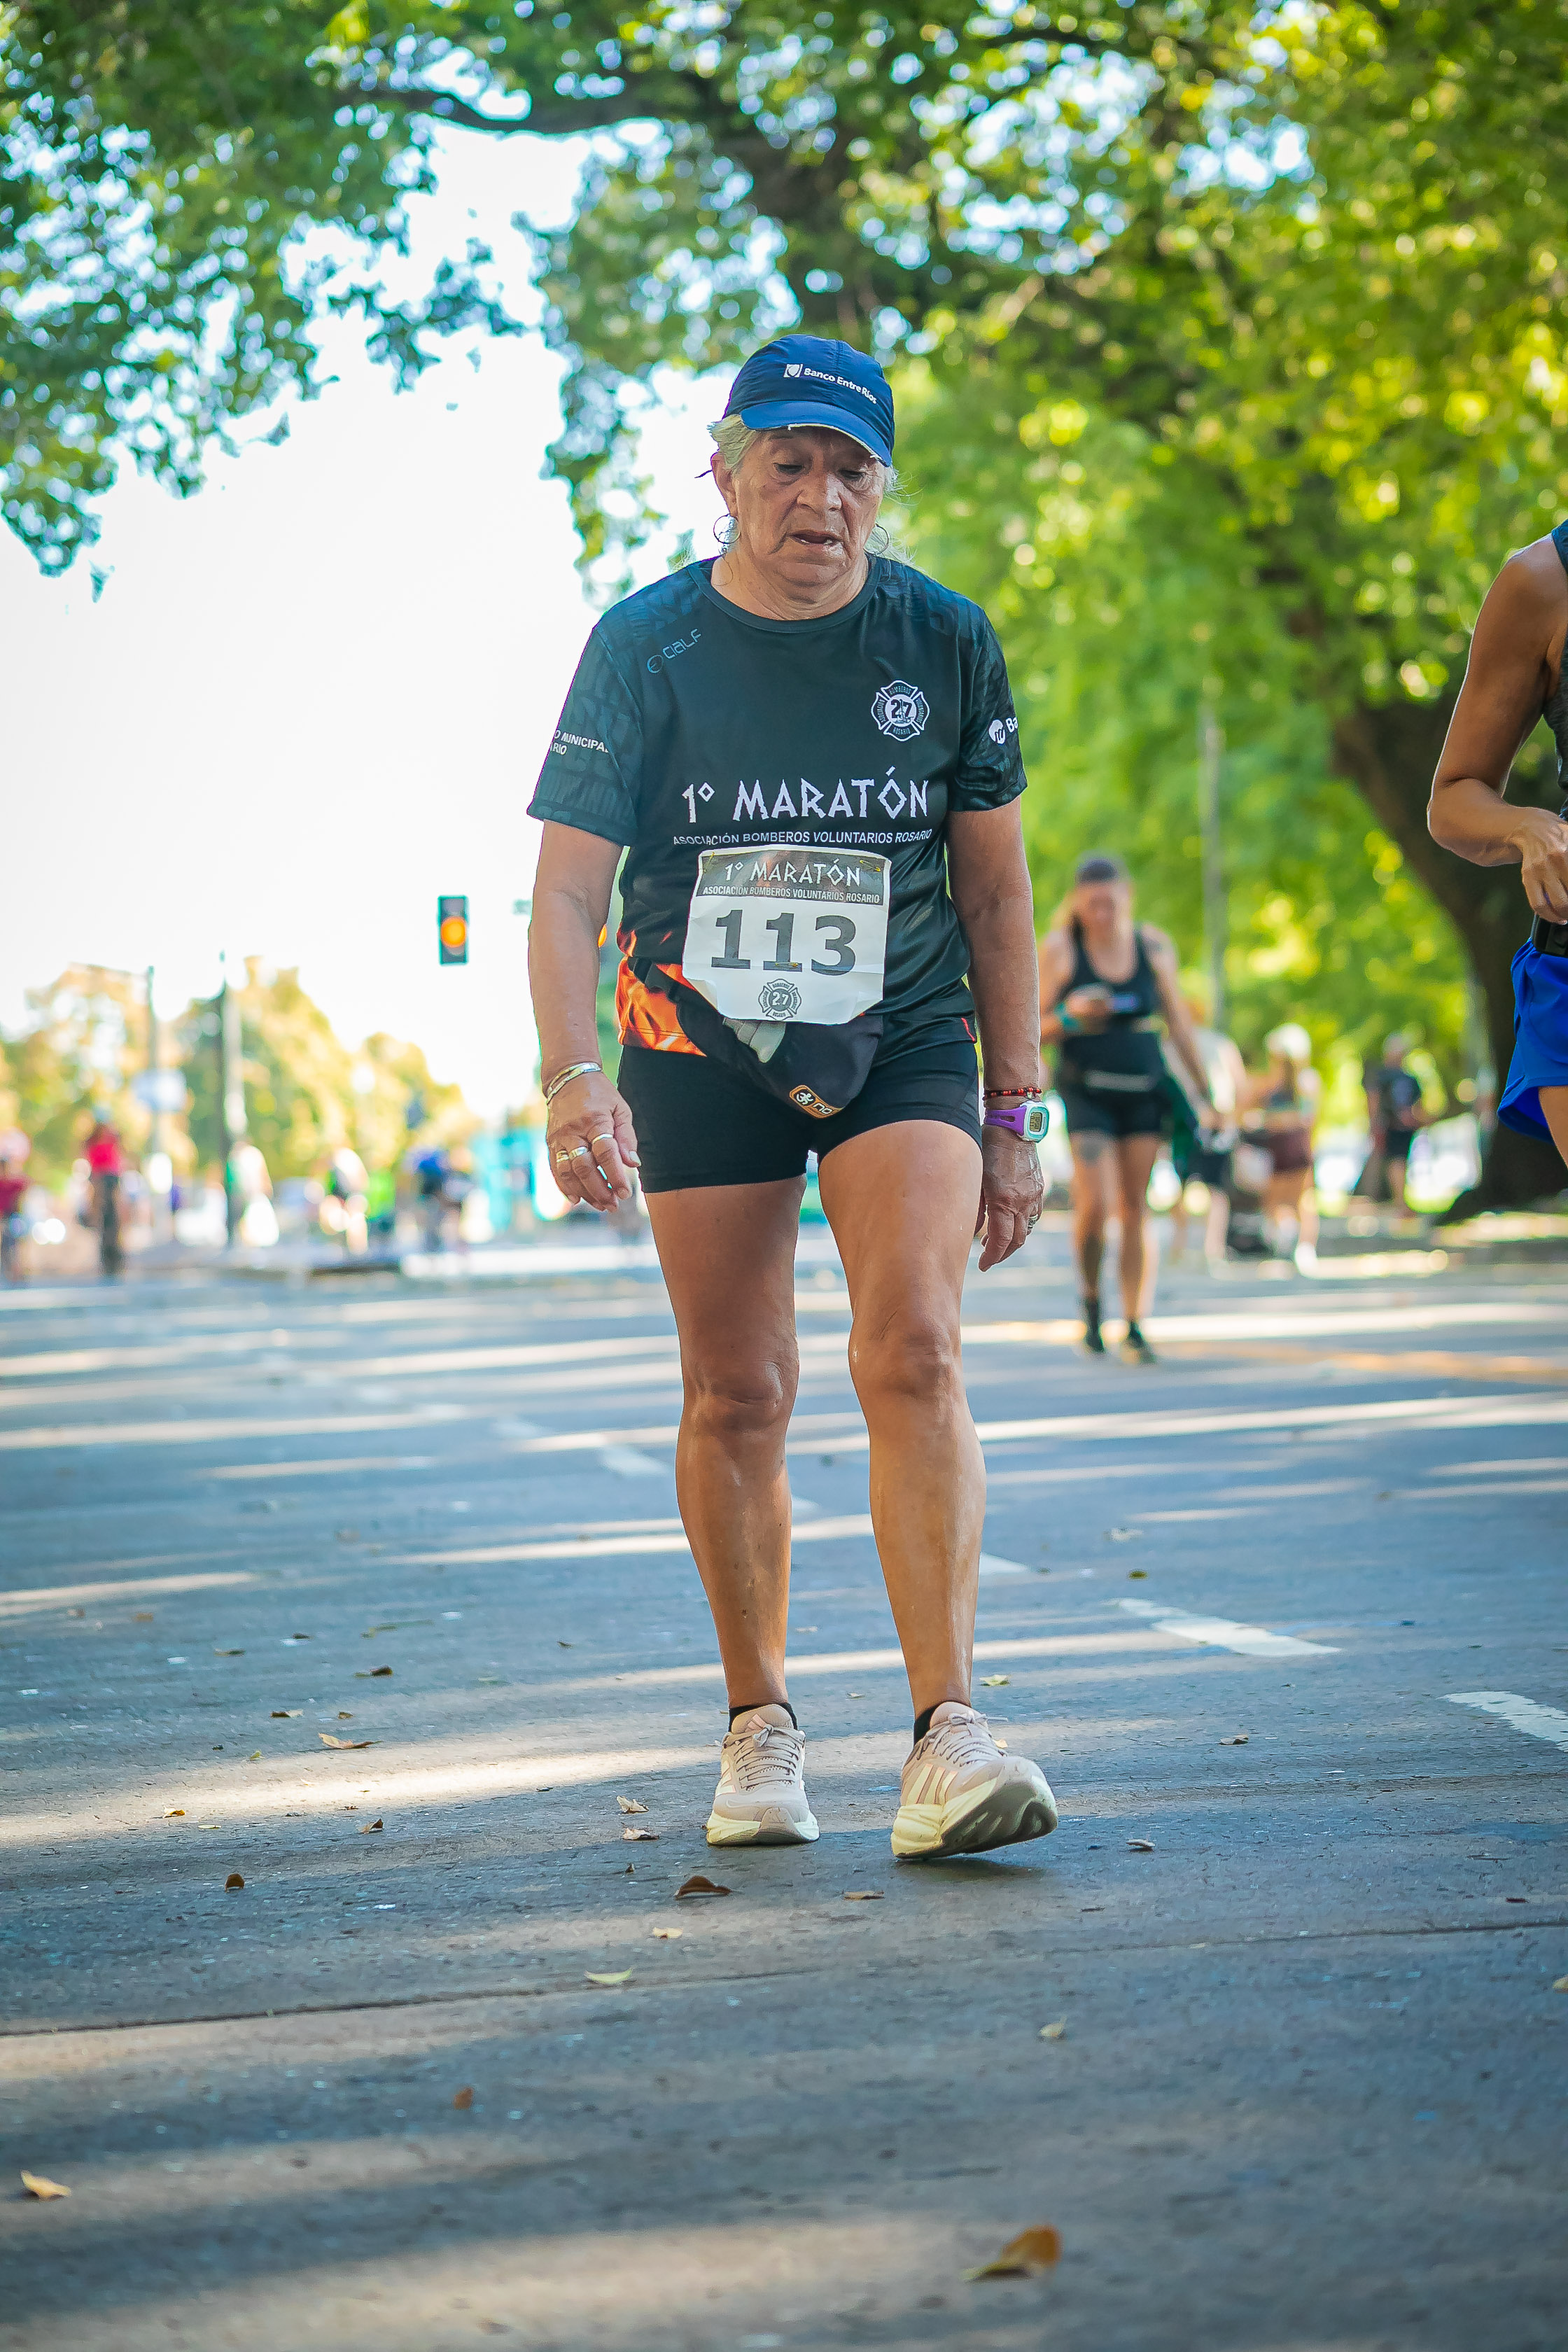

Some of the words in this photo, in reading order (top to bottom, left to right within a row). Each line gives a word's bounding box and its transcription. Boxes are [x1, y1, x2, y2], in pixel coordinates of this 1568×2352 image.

[804, 368, 836, 382] Banco
[836, 376, 862, 393] Entre
[890, 699, 913, 719] 27
[1005, 717, 1018, 733] Ba
[550, 742, 568, 755] RIO
[732, 765, 929, 821] MARATÓN
[673, 832, 739, 846] ASOCIACIÓN
[743, 831, 811, 843] BOMBEROS
[813, 831, 893, 844] VOLUNTARIOS
[895, 829, 932, 844] ROSARIO
[749, 858, 861, 888] MARATÓN
[749, 887, 791, 897] BOMBEROS
[792, 888, 844, 902] VOLUNTARIOS
[846, 892, 881, 904] ROSARIO
[711, 909, 857, 976] 113
[771, 991, 790, 1006] 27
